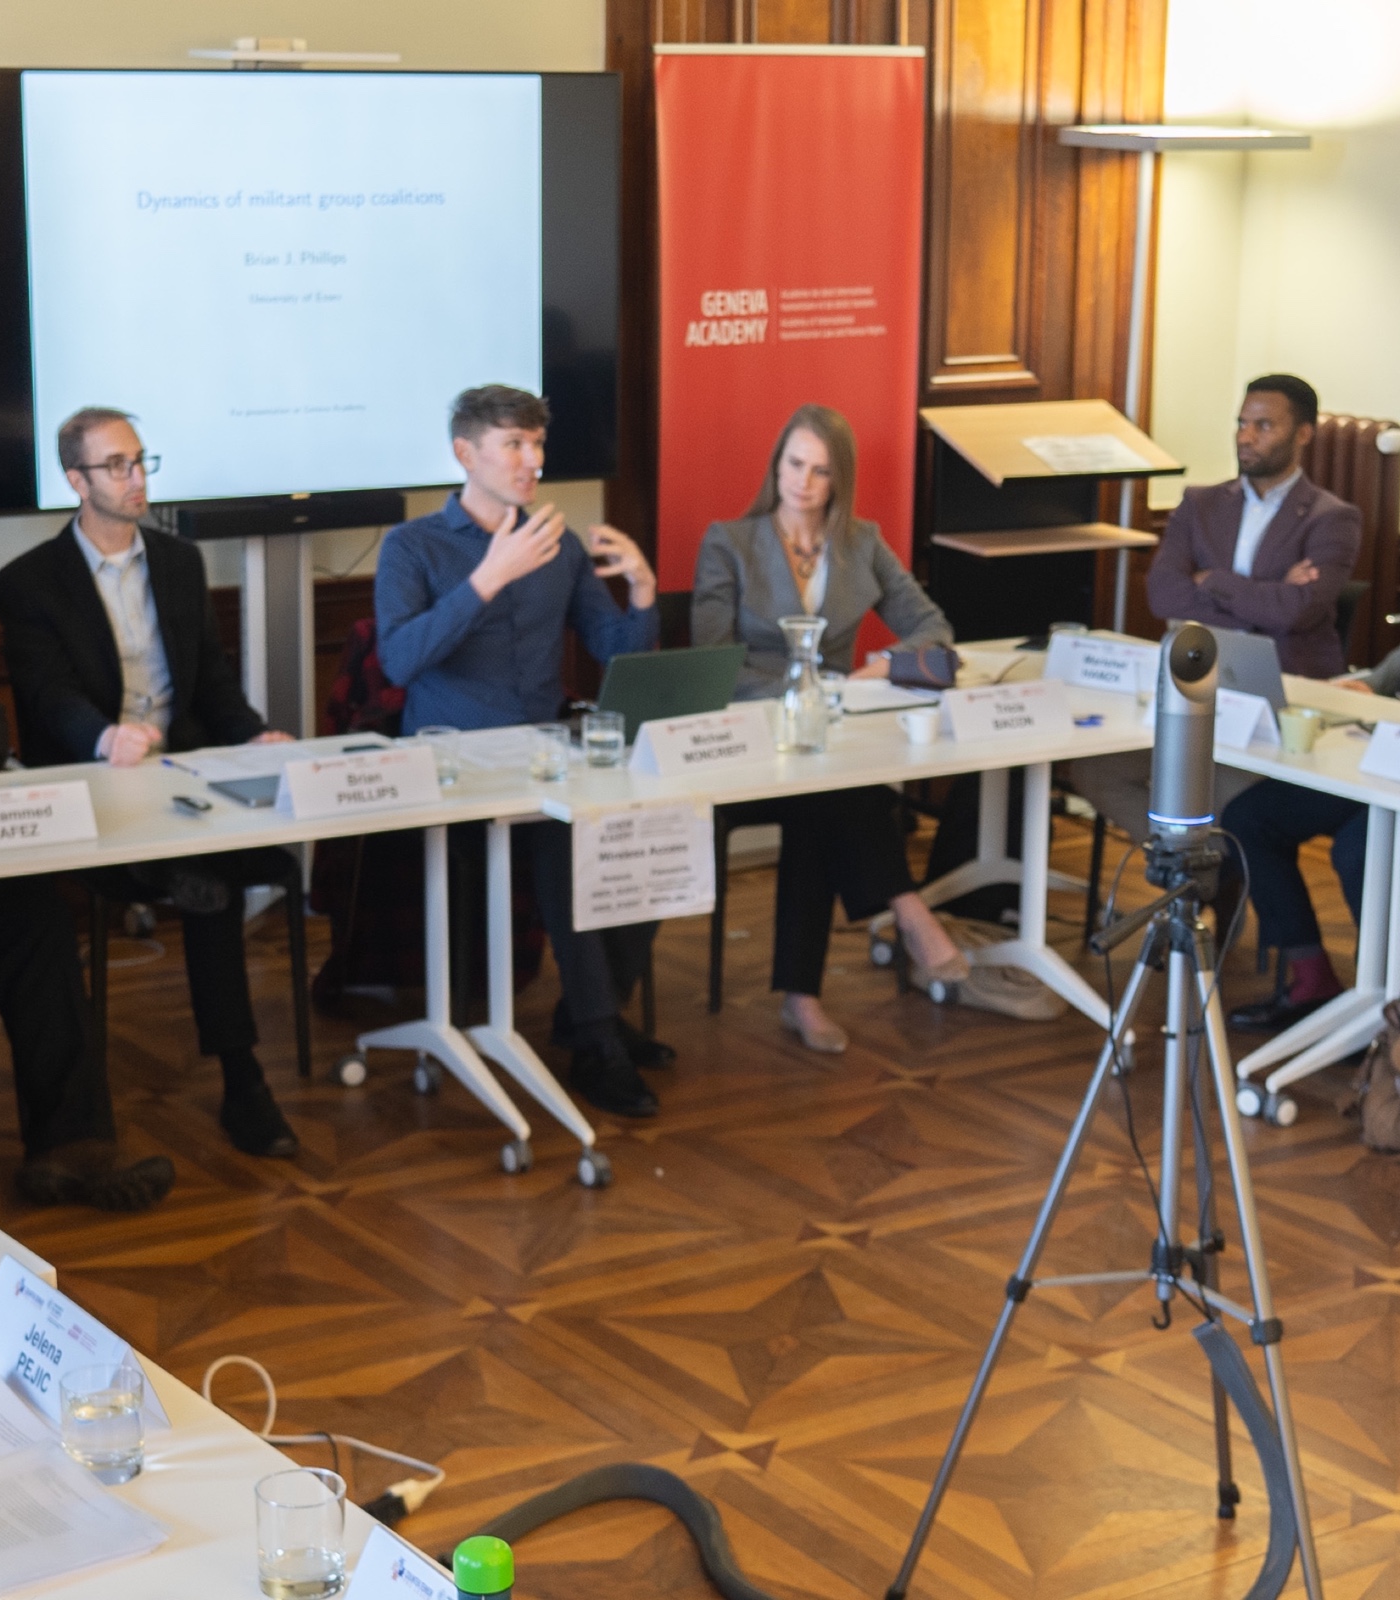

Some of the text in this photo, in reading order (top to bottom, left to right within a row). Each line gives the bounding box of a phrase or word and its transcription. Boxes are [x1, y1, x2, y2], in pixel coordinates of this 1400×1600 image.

[137, 189, 446, 213] Dynamics of militant group coalitions
[244, 252, 279, 266] Brian
[300, 250, 347, 266] Phillips
[701, 289, 769, 317] GENEVA
[685, 318, 768, 347] ACADEMY
[347, 772, 382, 787] Brian
[336, 786, 398, 805] PHILLIPS
[24, 1323, 63, 1365] Jelena
[16, 1351, 52, 1393] PEJIC
